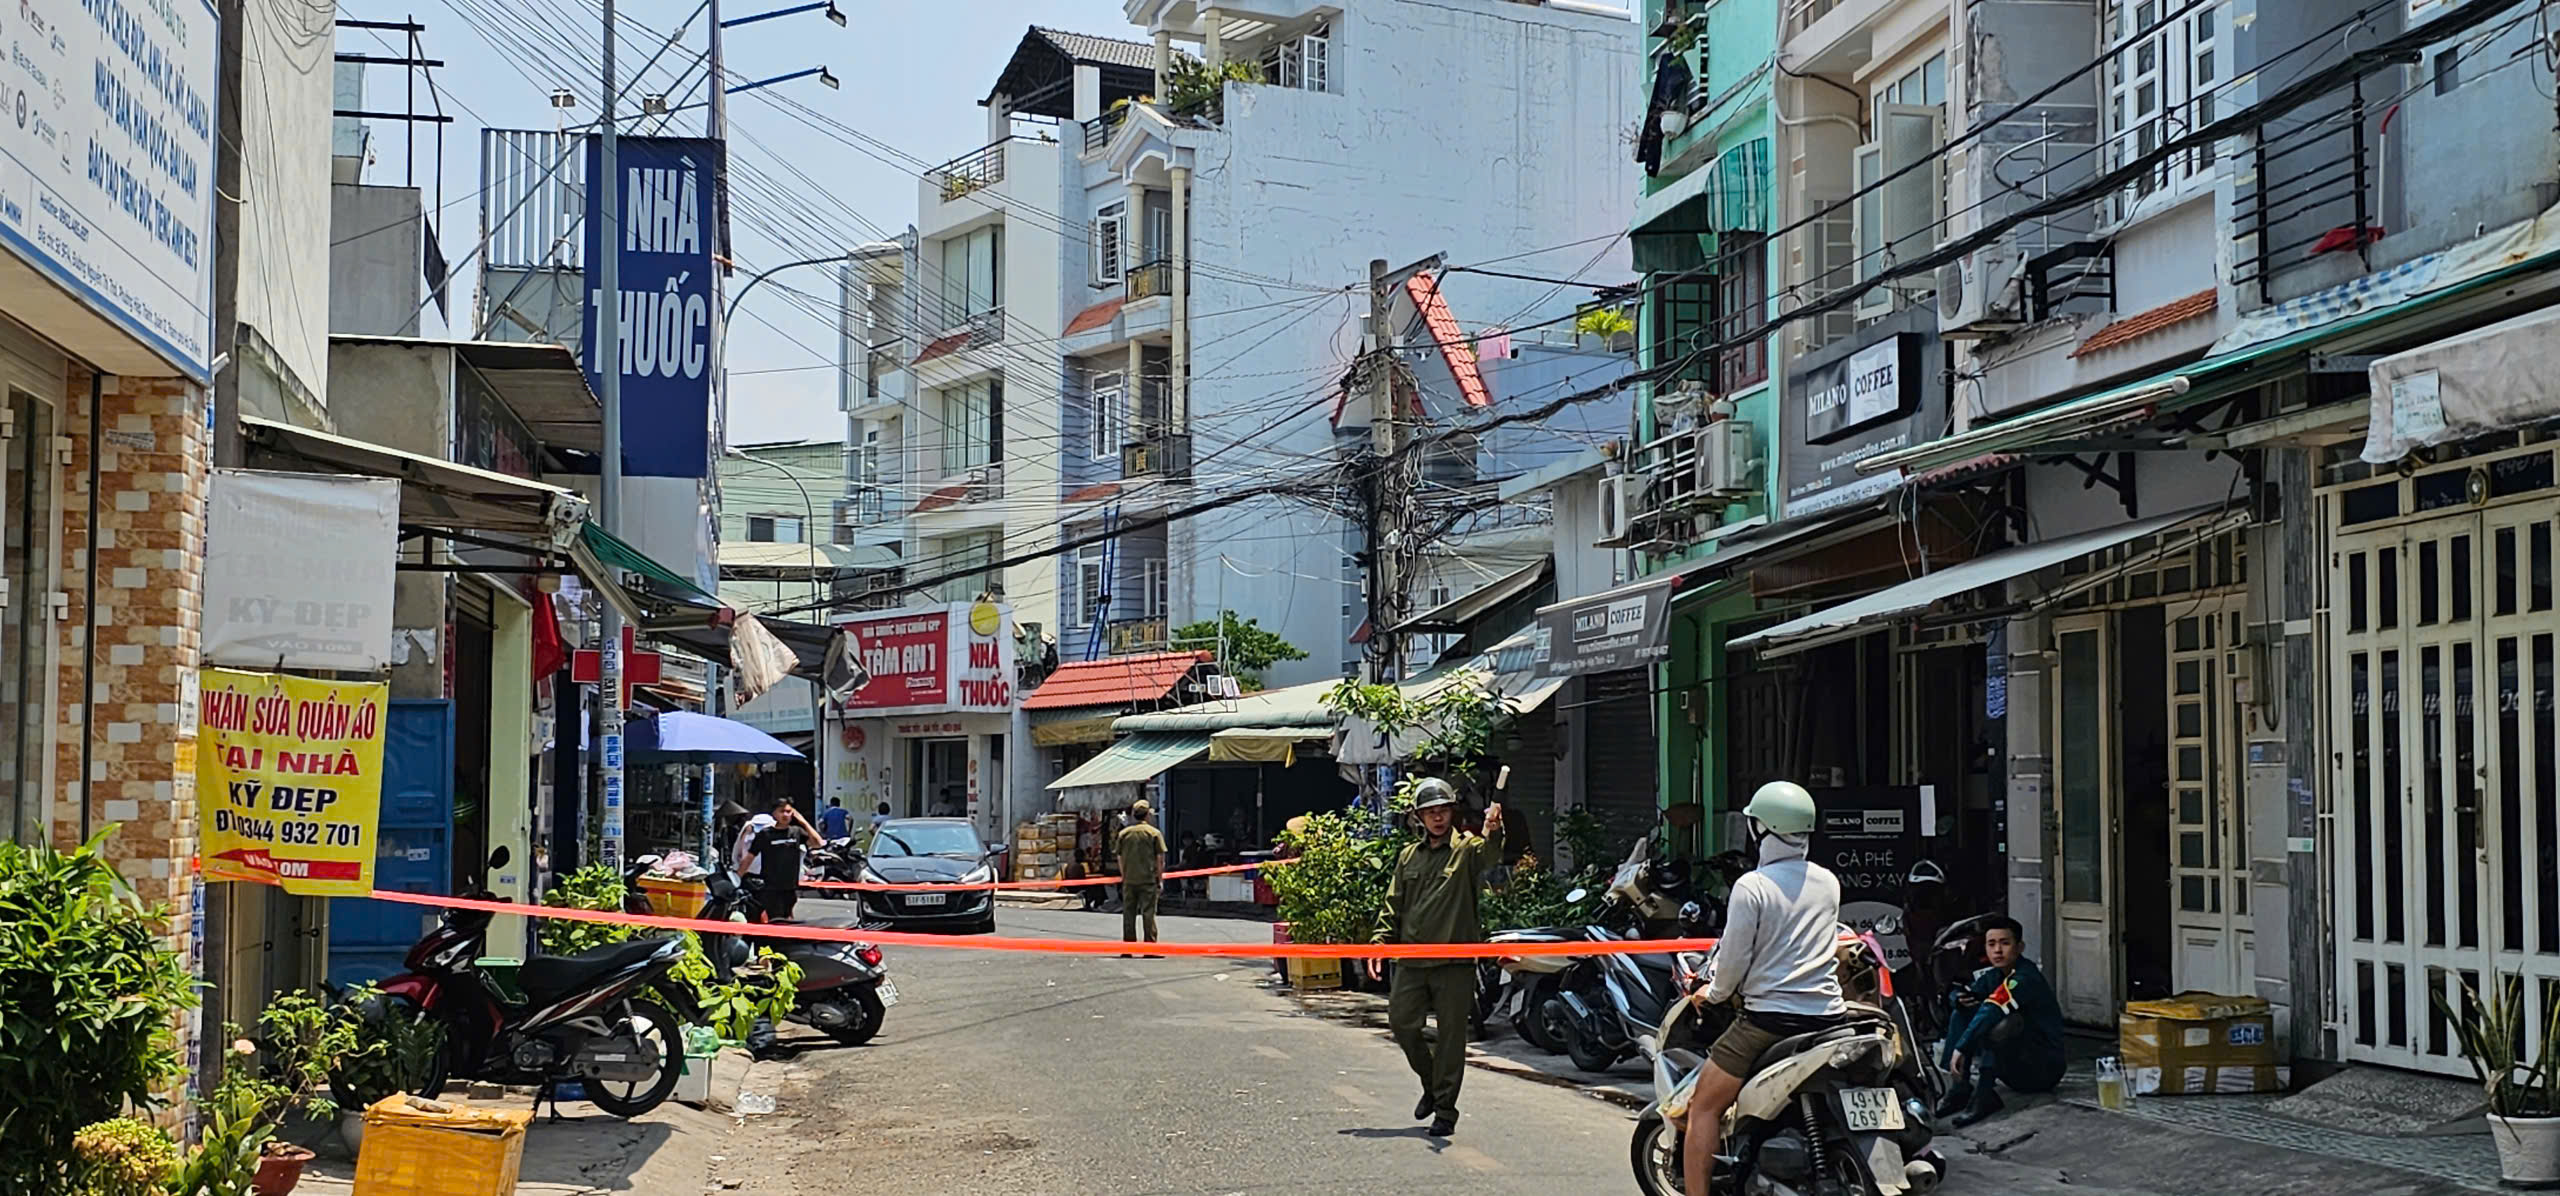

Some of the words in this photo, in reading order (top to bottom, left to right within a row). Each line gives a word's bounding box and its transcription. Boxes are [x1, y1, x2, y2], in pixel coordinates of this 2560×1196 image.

[626, 155, 700, 254] NHÀ
[1809, 383, 1847, 417] MILANO
[1855, 364, 1893, 397] COFFEE
[294, 600, 371, 632] ĐẸP
[1576, 612, 1605, 632] MILANO
[1610, 605, 1642, 624] COFFEE
[863, 639, 900, 676] TÂM
[969, 636, 999, 669] NHÀ
[959, 672, 1009, 706] THUỐC
[200, 684, 249, 739] NHẬN
[253, 684, 290, 736] SỬA
[297, 690, 350, 743] QUẦN
[351, 698, 376, 740] ÁO
[277, 748, 360, 775] NHÀ
[228, 780, 262, 808] KỸ
[272, 786, 337, 817] ĐẸP
[238, 815, 274, 842] 0344
[281, 821, 319, 844] 932
[325, 824, 360, 846] 701
[1866, 817, 1900, 825] COFFEE
[1836, 849, 1860, 867] CÀ
[1865, 849, 1894, 867] PHÊ
[1876, 873, 1905, 888] XAY
